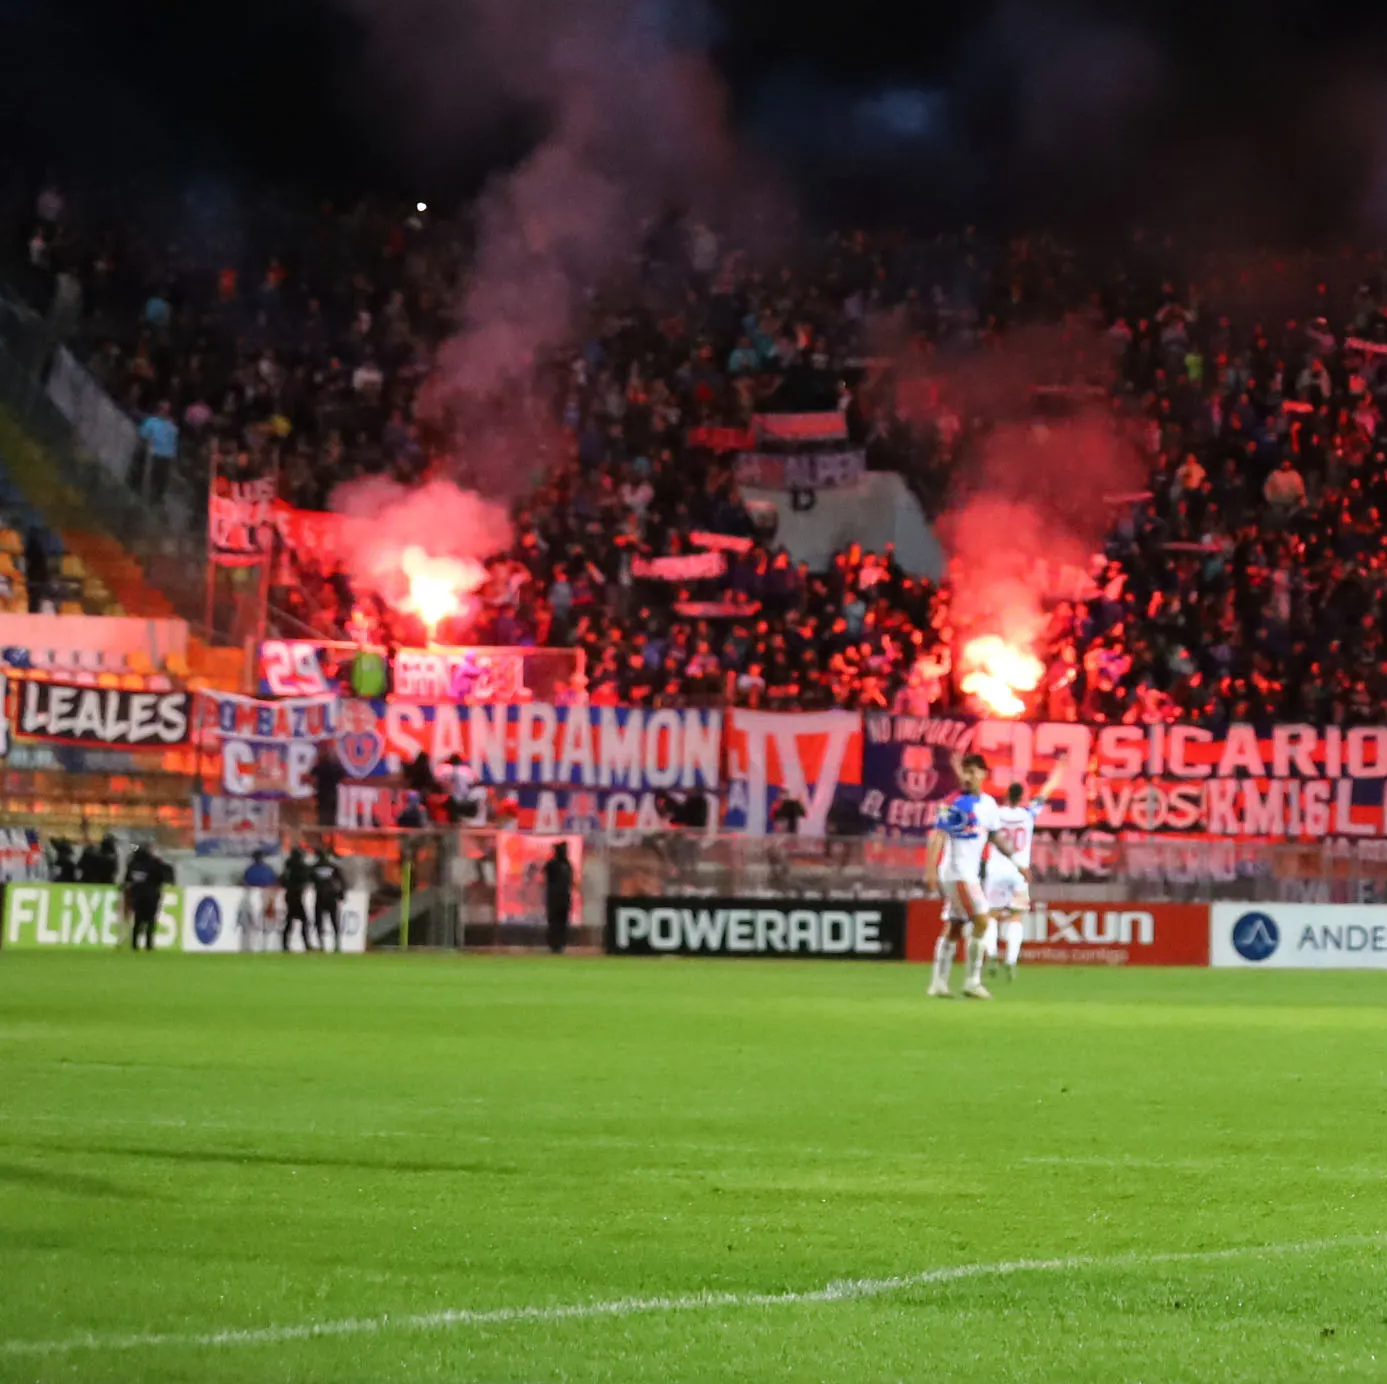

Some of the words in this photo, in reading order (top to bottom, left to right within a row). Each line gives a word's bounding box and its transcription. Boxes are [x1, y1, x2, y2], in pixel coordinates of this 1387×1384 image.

[22, 681, 187, 742] LEALES
[516, 703, 722, 788] RAMON
[617, 908, 883, 952] POWERADE
